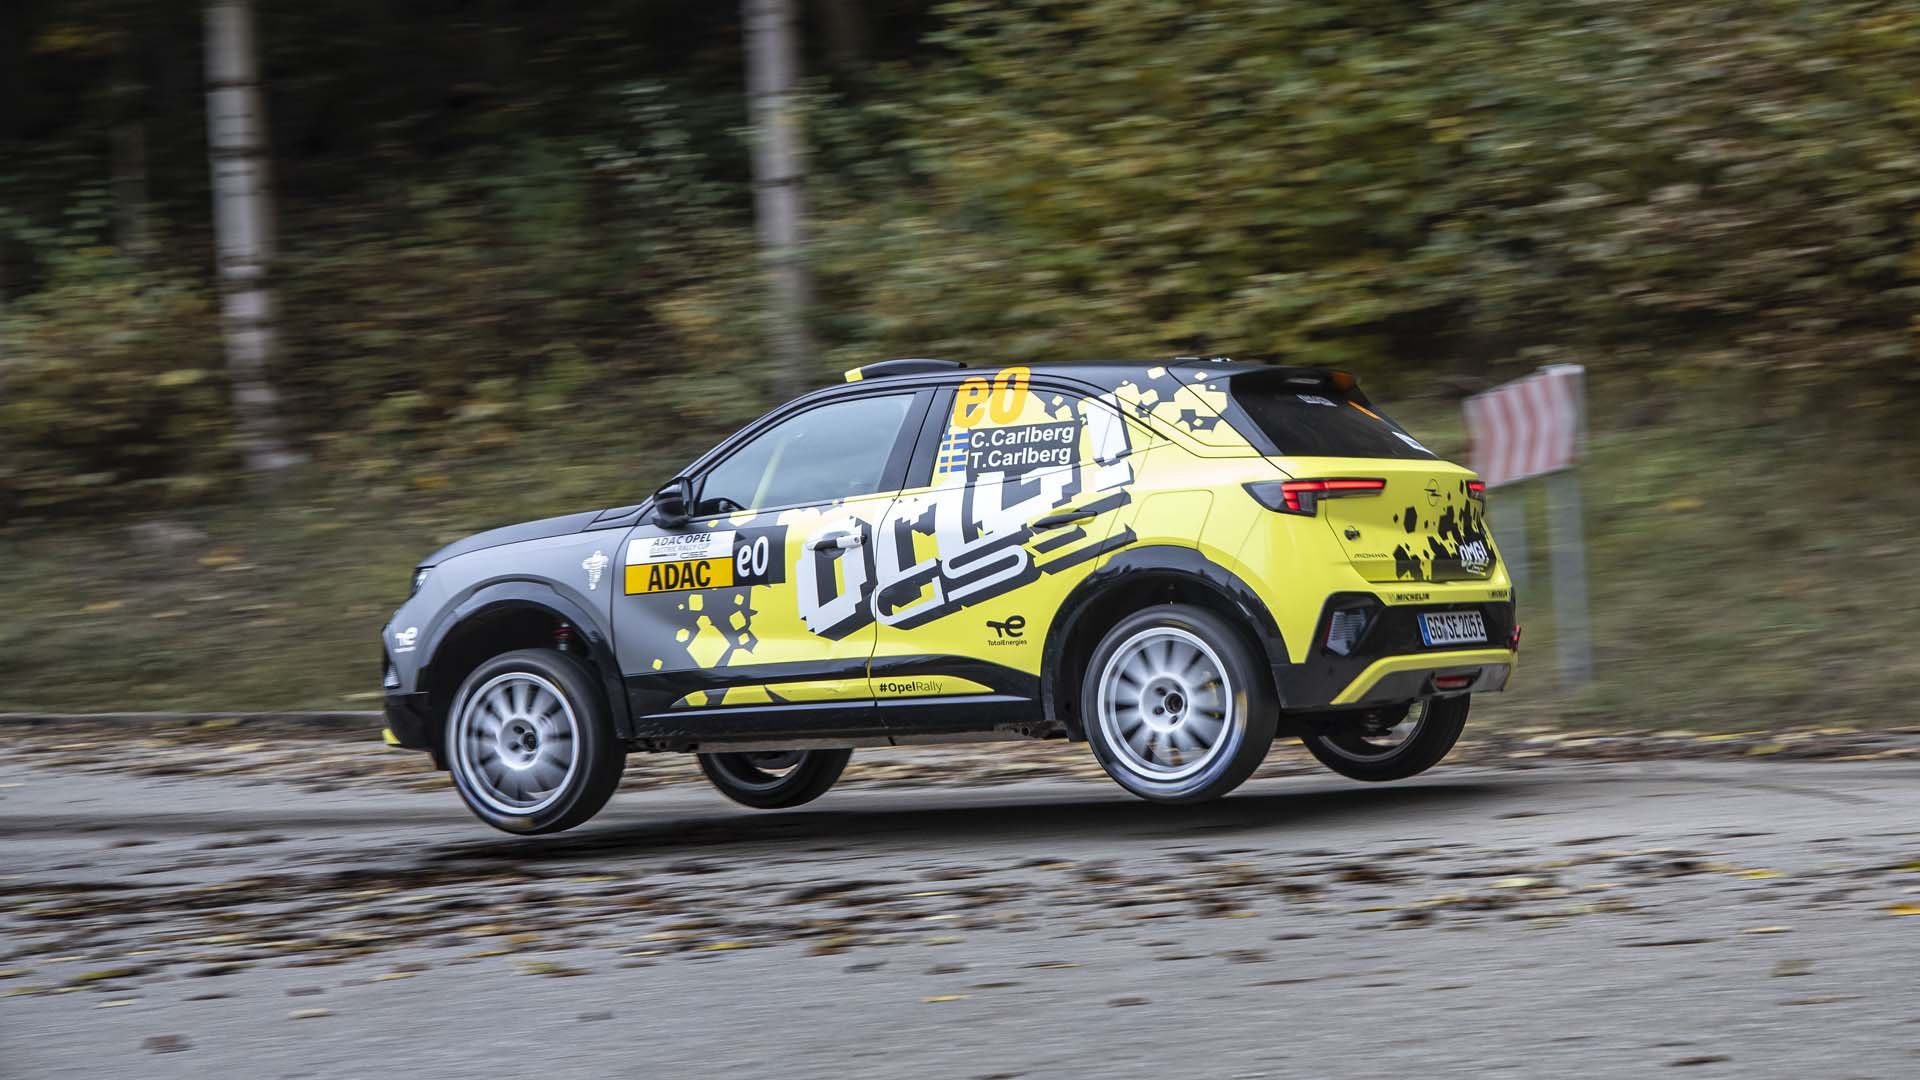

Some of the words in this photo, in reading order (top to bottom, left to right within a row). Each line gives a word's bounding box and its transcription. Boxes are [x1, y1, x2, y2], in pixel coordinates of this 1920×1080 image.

[971, 426, 1075, 448] C.Carlberg
[971, 447, 1072, 469] T.Carlberg
[652, 536, 684, 546] ADAC
[685, 533, 711, 544] OPEL
[648, 561, 711, 591] ADAC
[1427, 616, 1443, 640] GG
[987, 639, 1028, 647] TotalEnergies
[879, 680, 943, 695] #OpelRally
